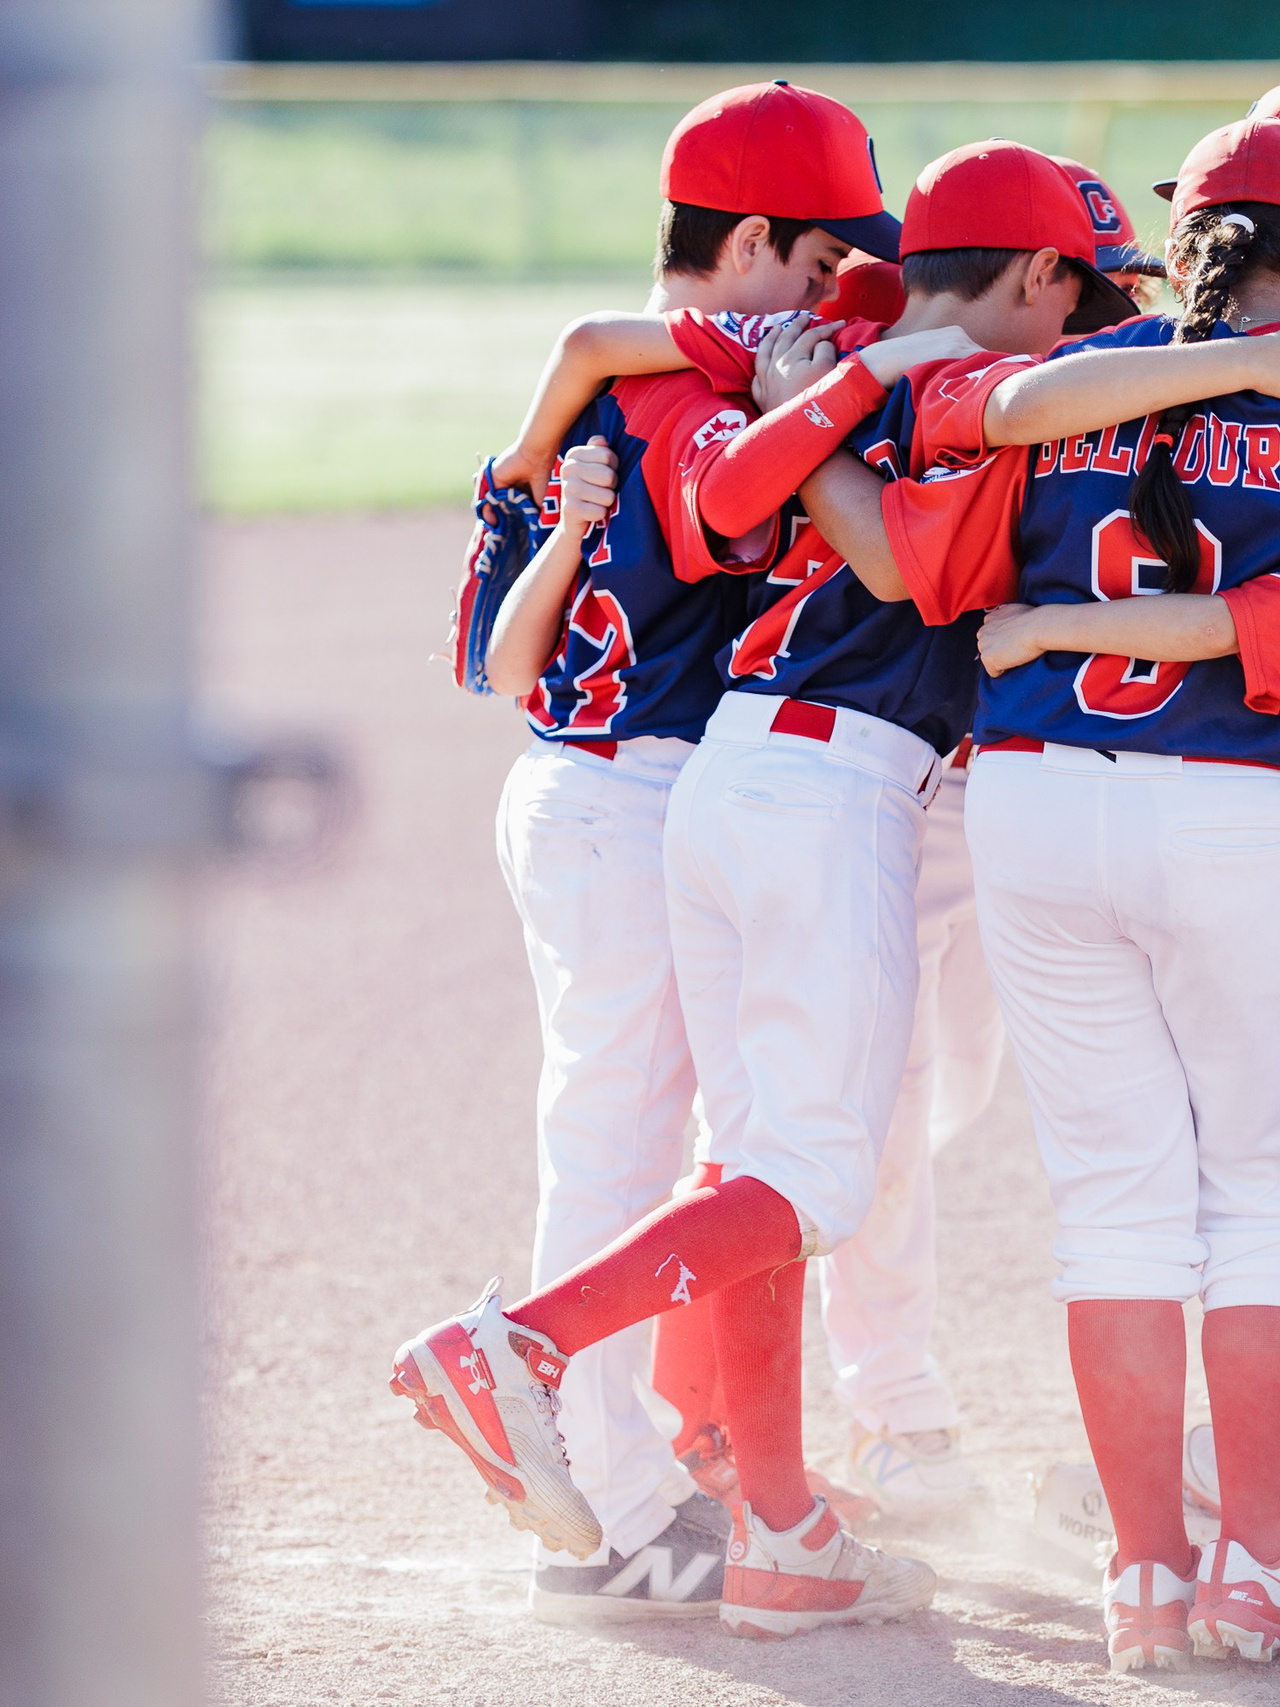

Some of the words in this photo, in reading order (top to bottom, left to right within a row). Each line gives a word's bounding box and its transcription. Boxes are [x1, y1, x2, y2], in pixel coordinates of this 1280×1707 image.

[1077, 180, 1122, 234] C
[1072, 508, 1223, 720] 8
[537, 1359, 561, 1380] BH
[595, 1543, 722, 1602] N
